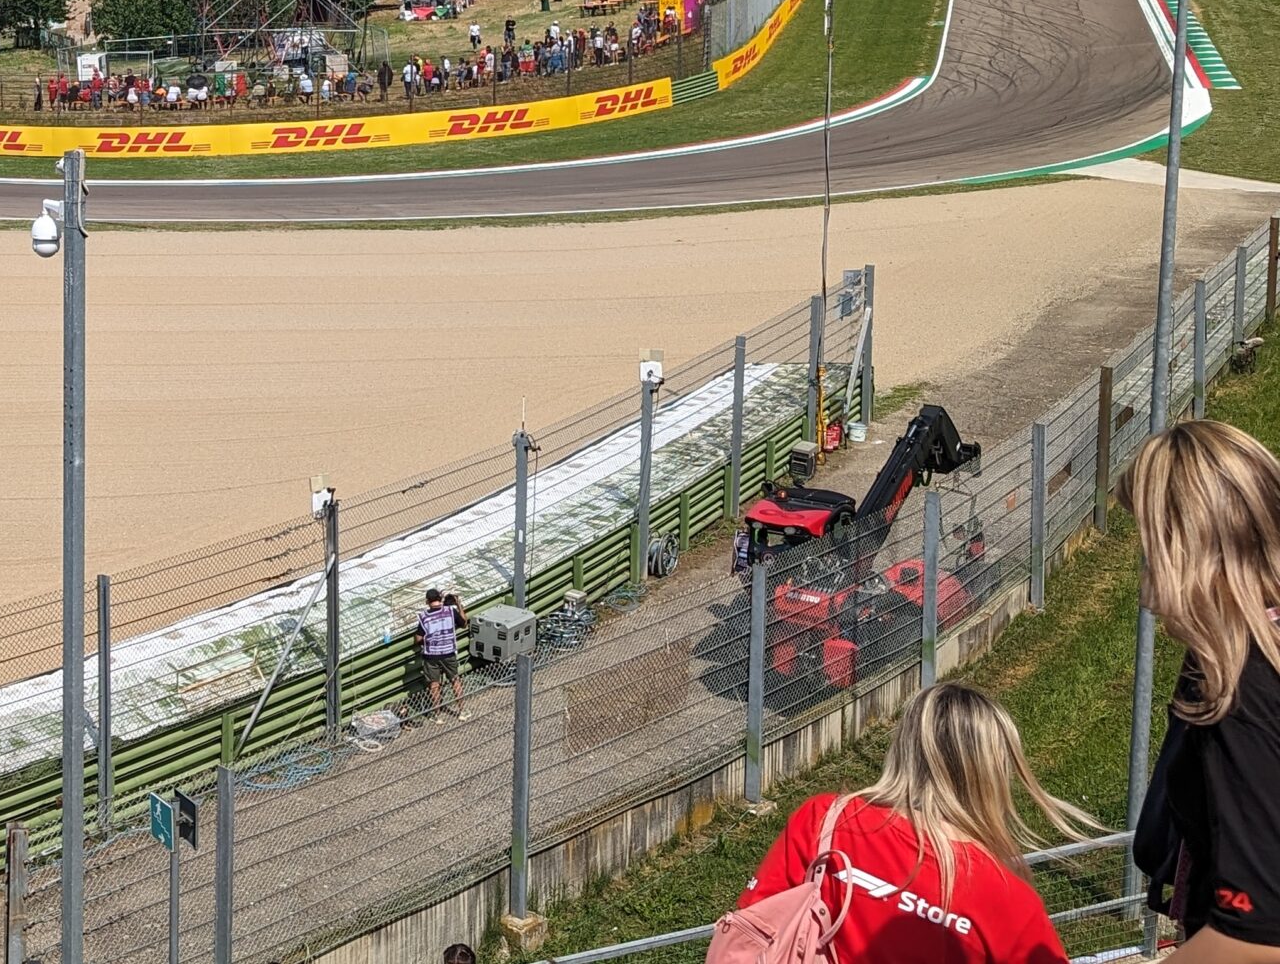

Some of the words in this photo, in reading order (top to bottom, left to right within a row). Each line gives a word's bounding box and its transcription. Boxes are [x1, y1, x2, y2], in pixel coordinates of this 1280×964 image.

[594, 86, 658, 117] DHL
[270, 123, 370, 148] DHL
[447, 108, 534, 137] DHL
[97, 132, 193, 152] DHL
[897, 891, 972, 935] Store
